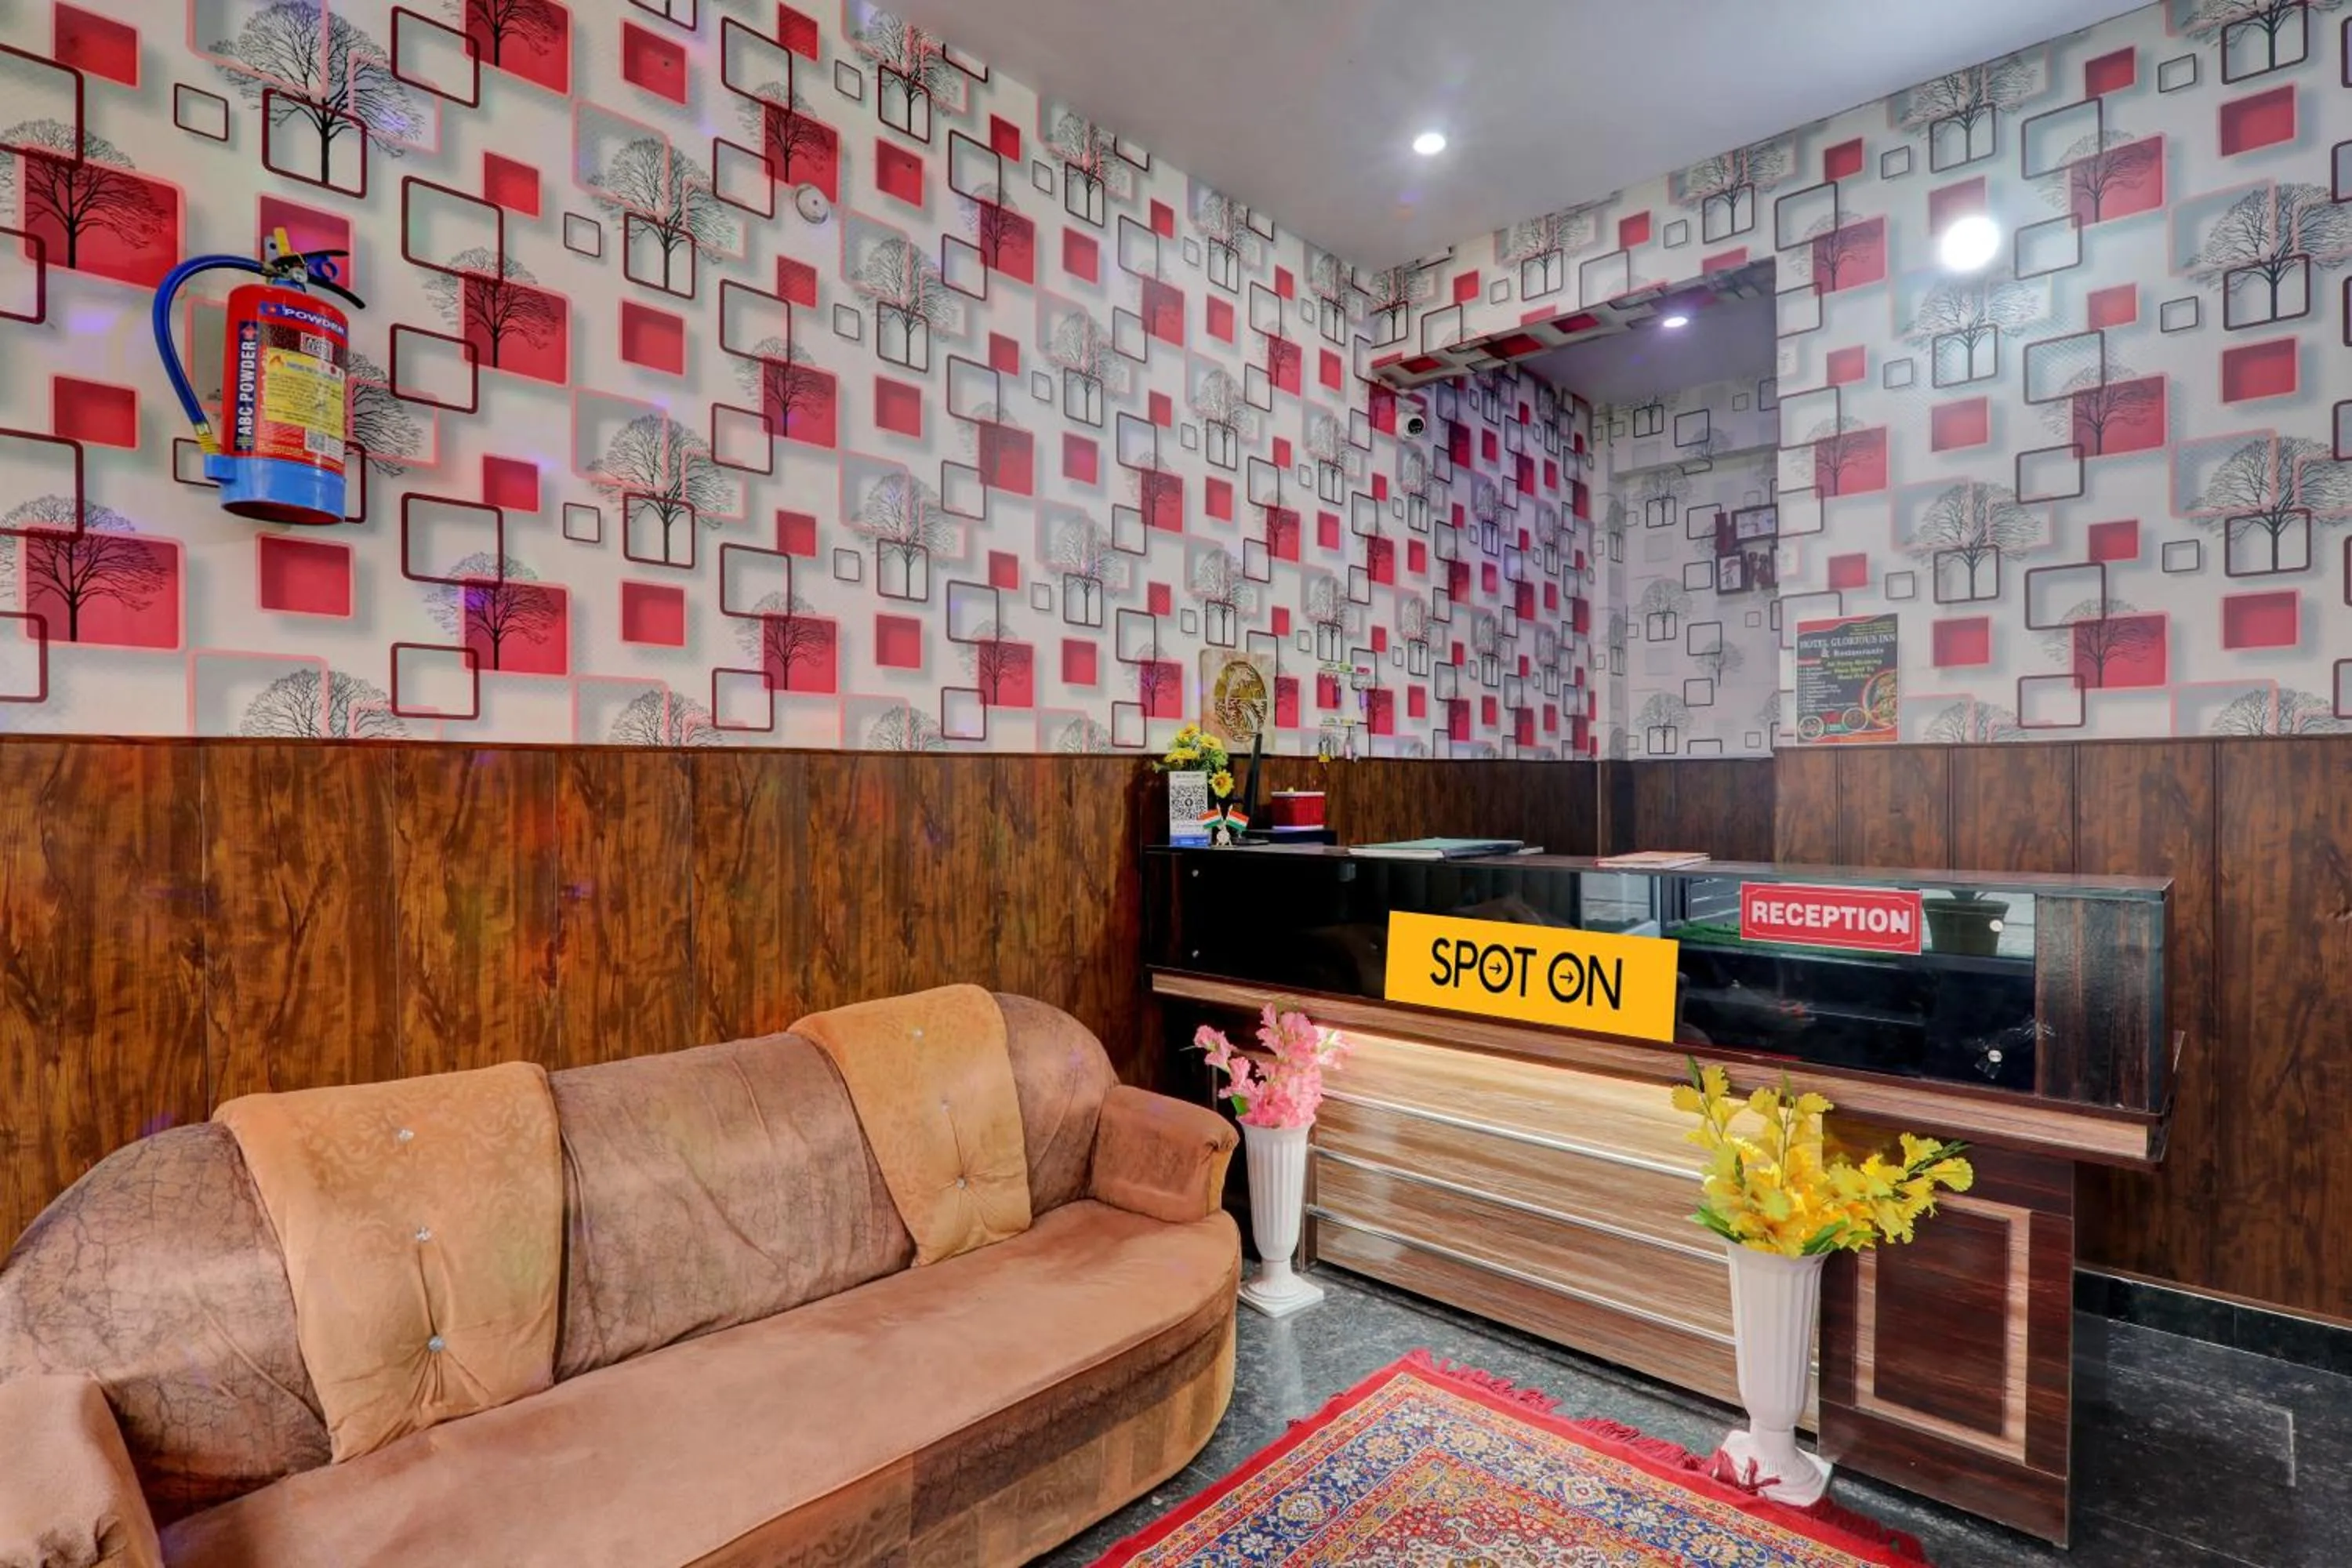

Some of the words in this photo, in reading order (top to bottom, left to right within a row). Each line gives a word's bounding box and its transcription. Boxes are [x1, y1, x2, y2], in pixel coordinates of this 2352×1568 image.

[283, 307, 345, 336] POWDER
[239, 341, 256, 401] POWDER
[238, 406, 253, 435] ABC
[1751, 901, 1910, 934] RECEPTION
[1430, 938, 1537, 997] SPOT
[1548, 952, 1623, 1011] ON
